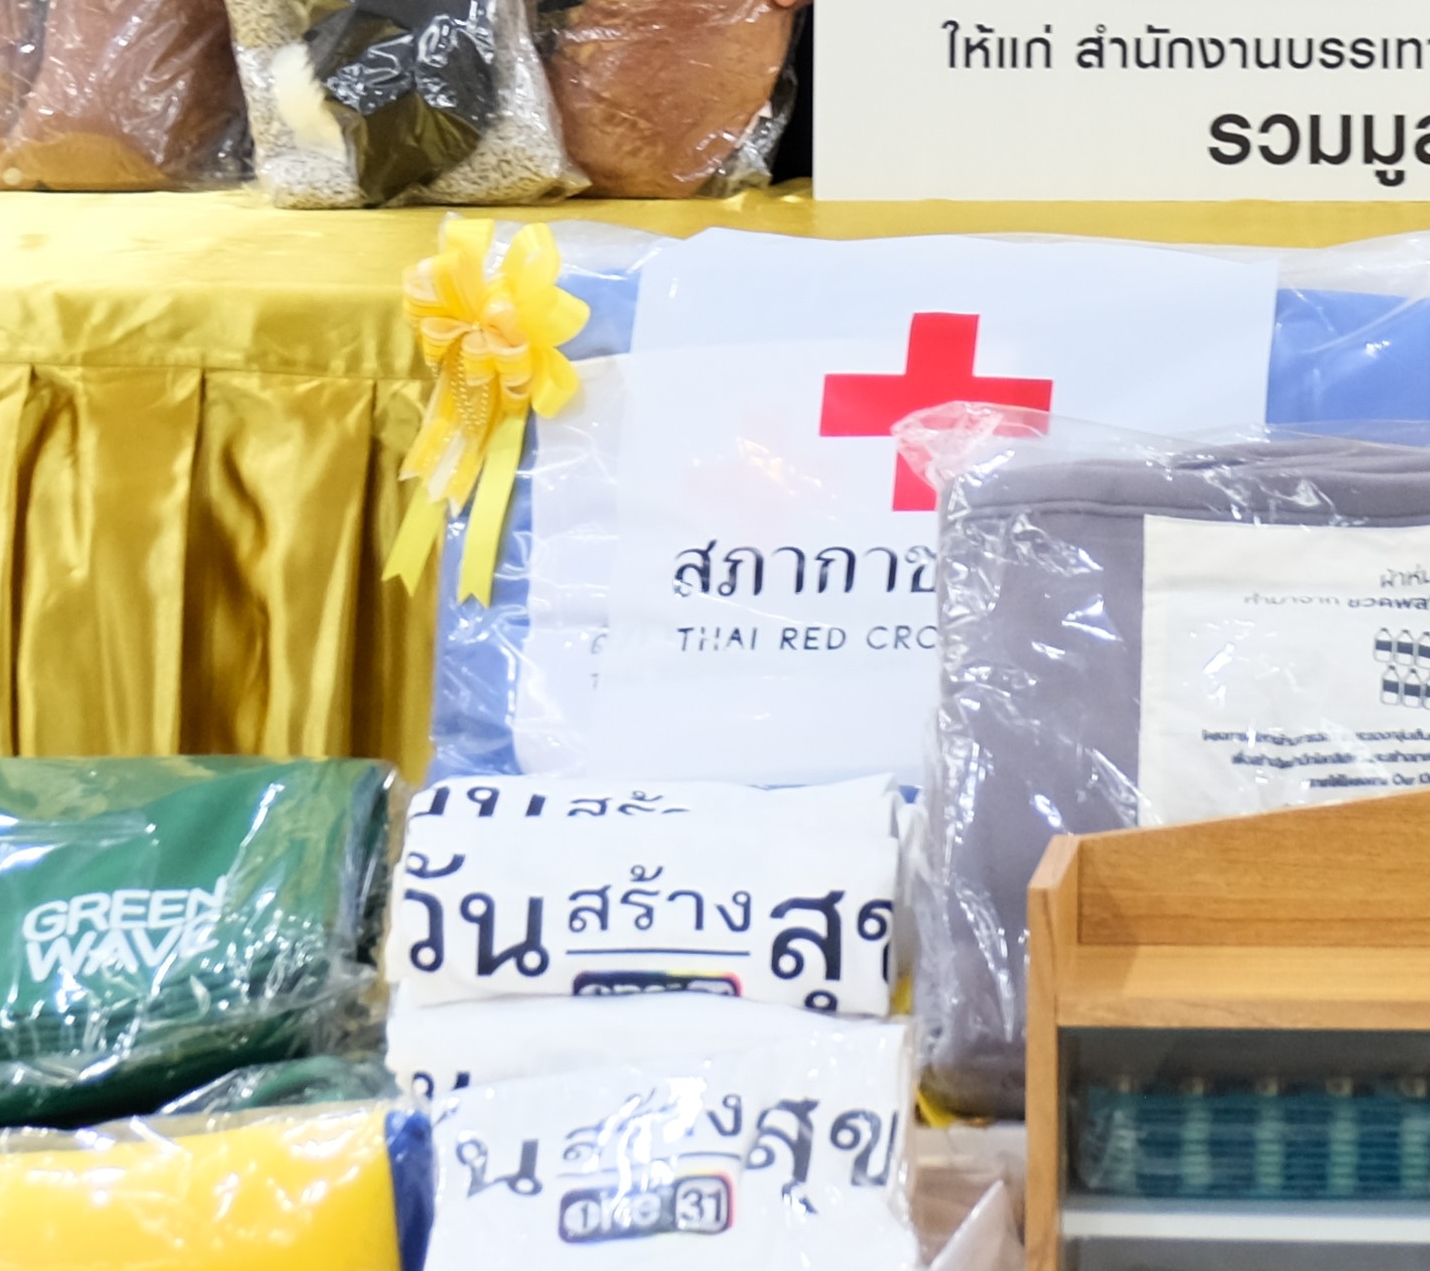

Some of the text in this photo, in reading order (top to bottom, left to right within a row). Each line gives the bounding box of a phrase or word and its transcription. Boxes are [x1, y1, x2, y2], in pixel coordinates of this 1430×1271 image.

[941, 20, 1052, 70] ให้แก่
[677, 624, 938, 652] THAI RED CRO
[22, 876, 227, 943] GREEN
[568, 865, 752, 934] สร้าง
[26, 912, 221, 983] WAVE
